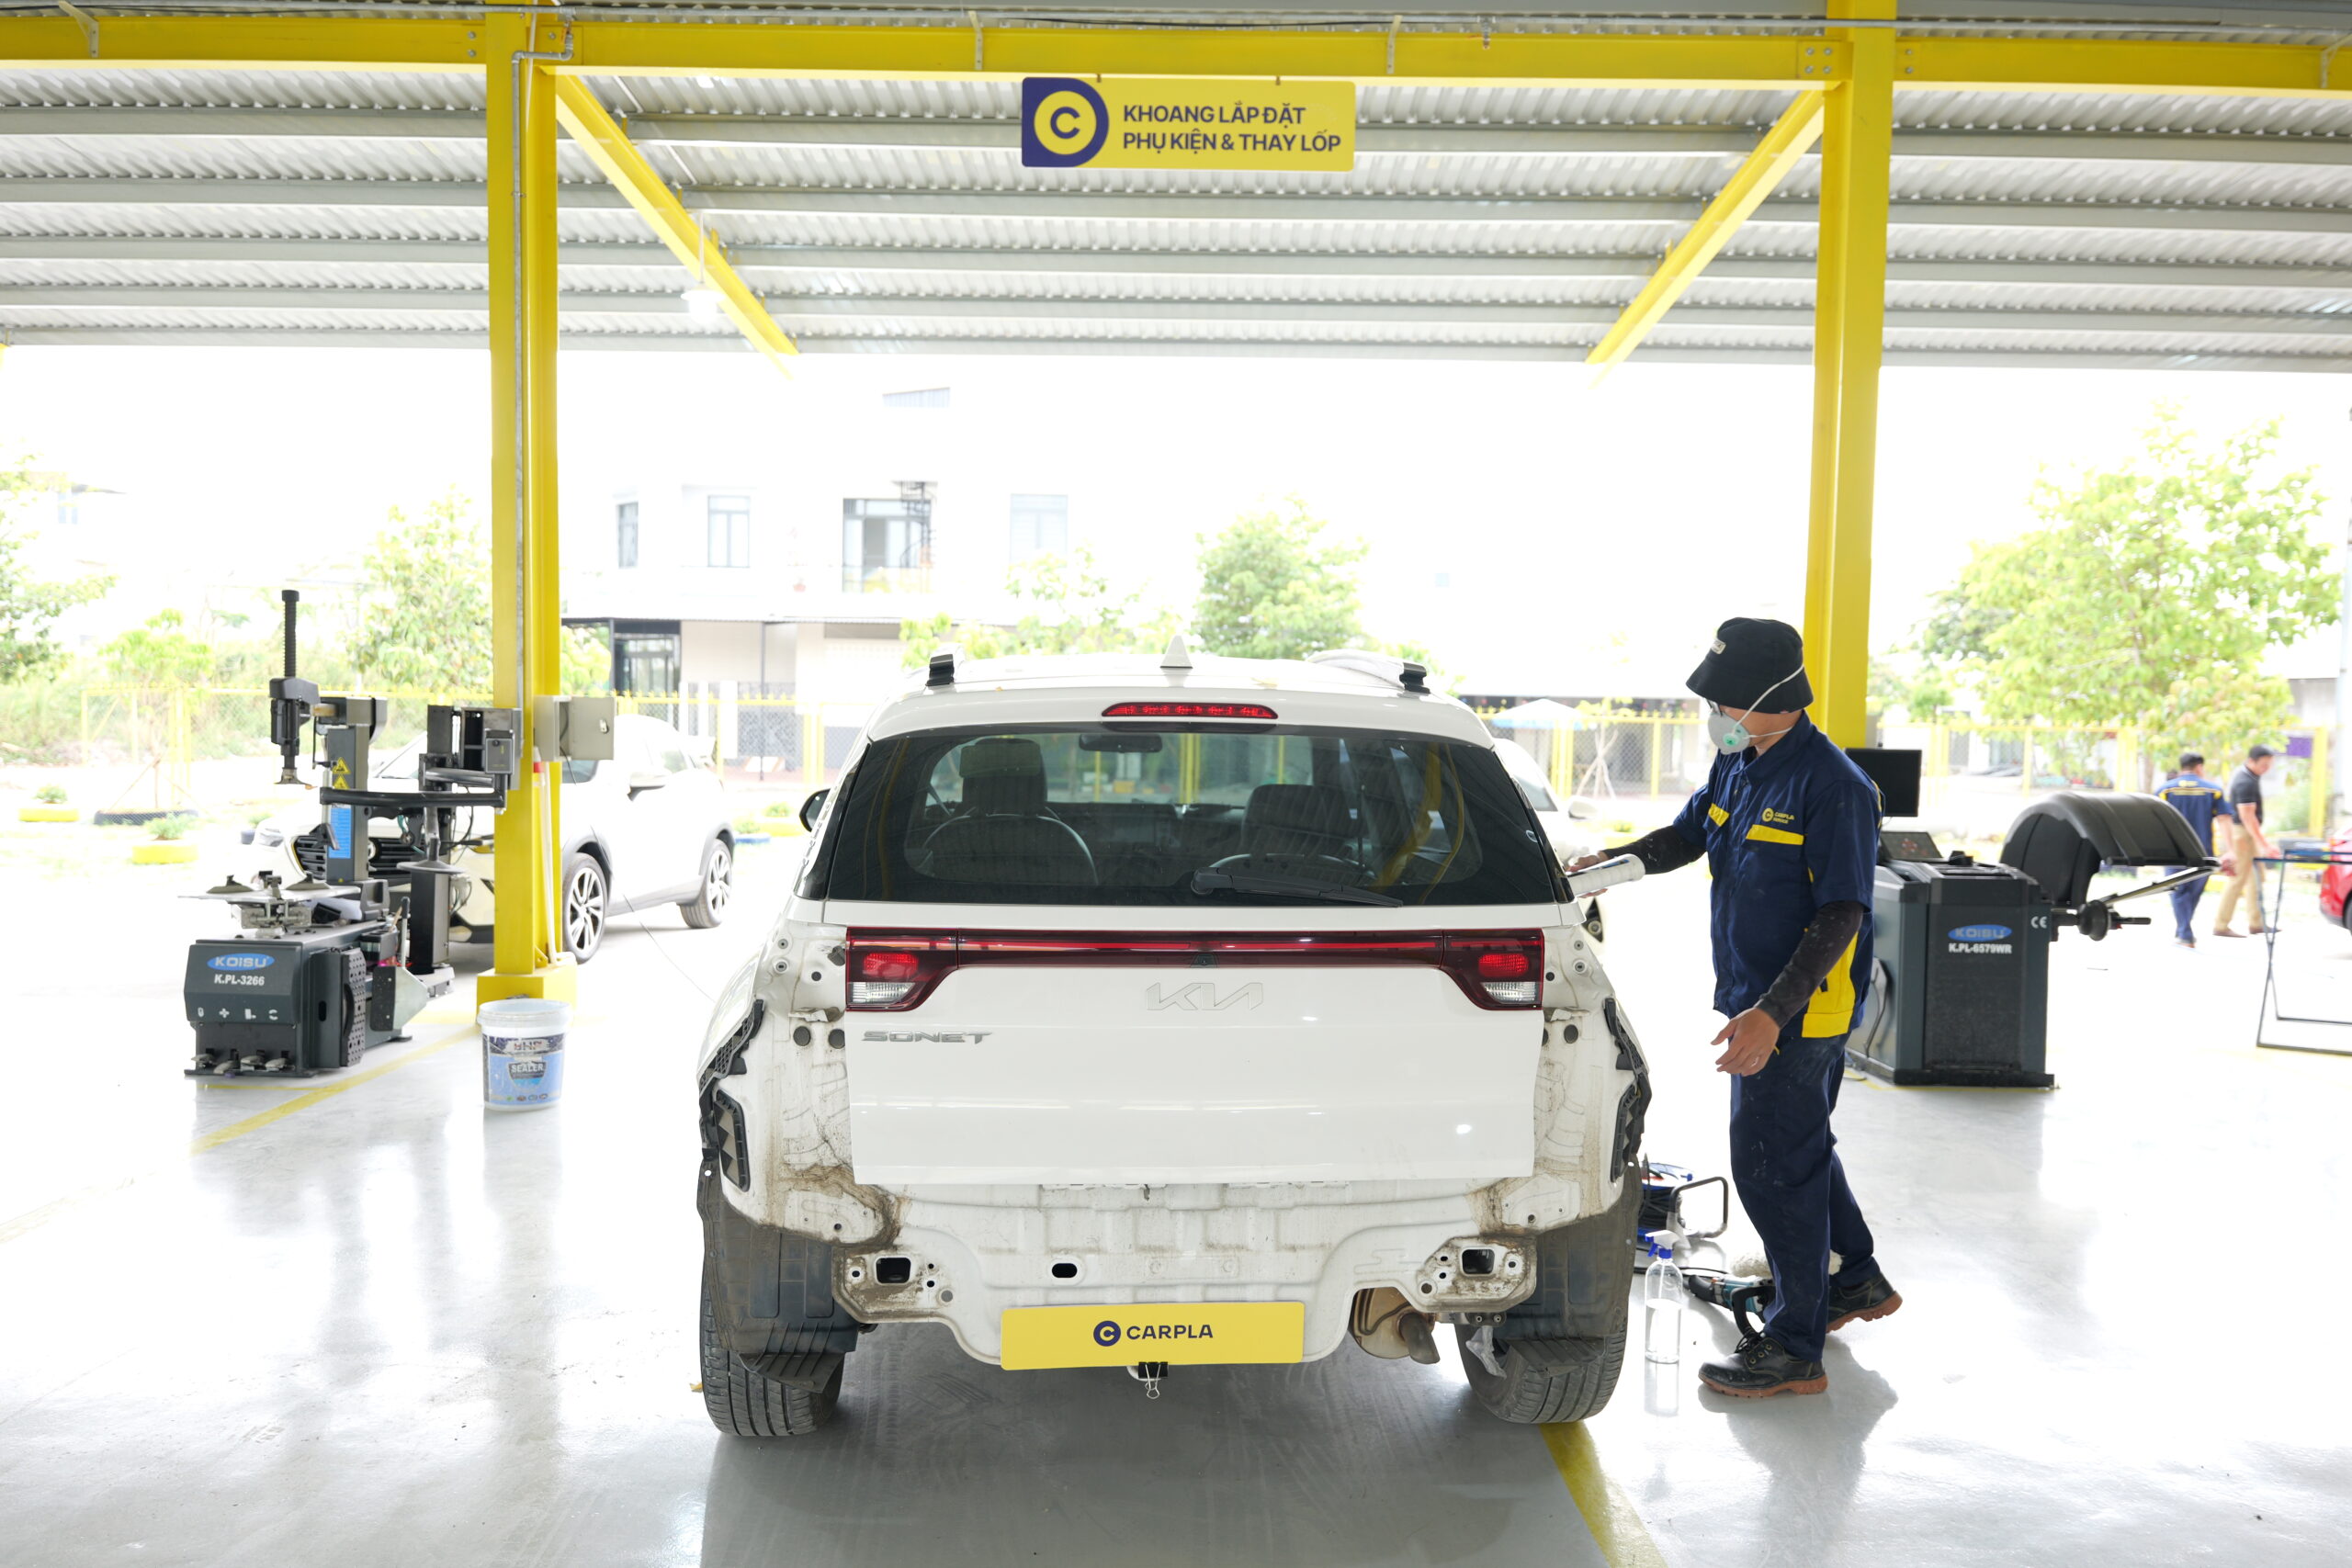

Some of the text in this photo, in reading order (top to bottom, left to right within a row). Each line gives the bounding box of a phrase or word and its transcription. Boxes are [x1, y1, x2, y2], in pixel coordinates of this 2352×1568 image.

[1124, 100, 1306, 129] KHOANG LẮP ĐẶT
[1124, 128, 1341, 154] PHỤ KIỆN & THAY LỐP
[2030, 916, 2048, 929] CE
[214, 974, 266, 986] K.PL-3266
[1146, 982, 1263, 1010] KIA
[862, 1031, 992, 1044] SONET
[511, 1063, 544, 1073] SEALER
[1126, 1325, 1214, 1339] CARPLA
